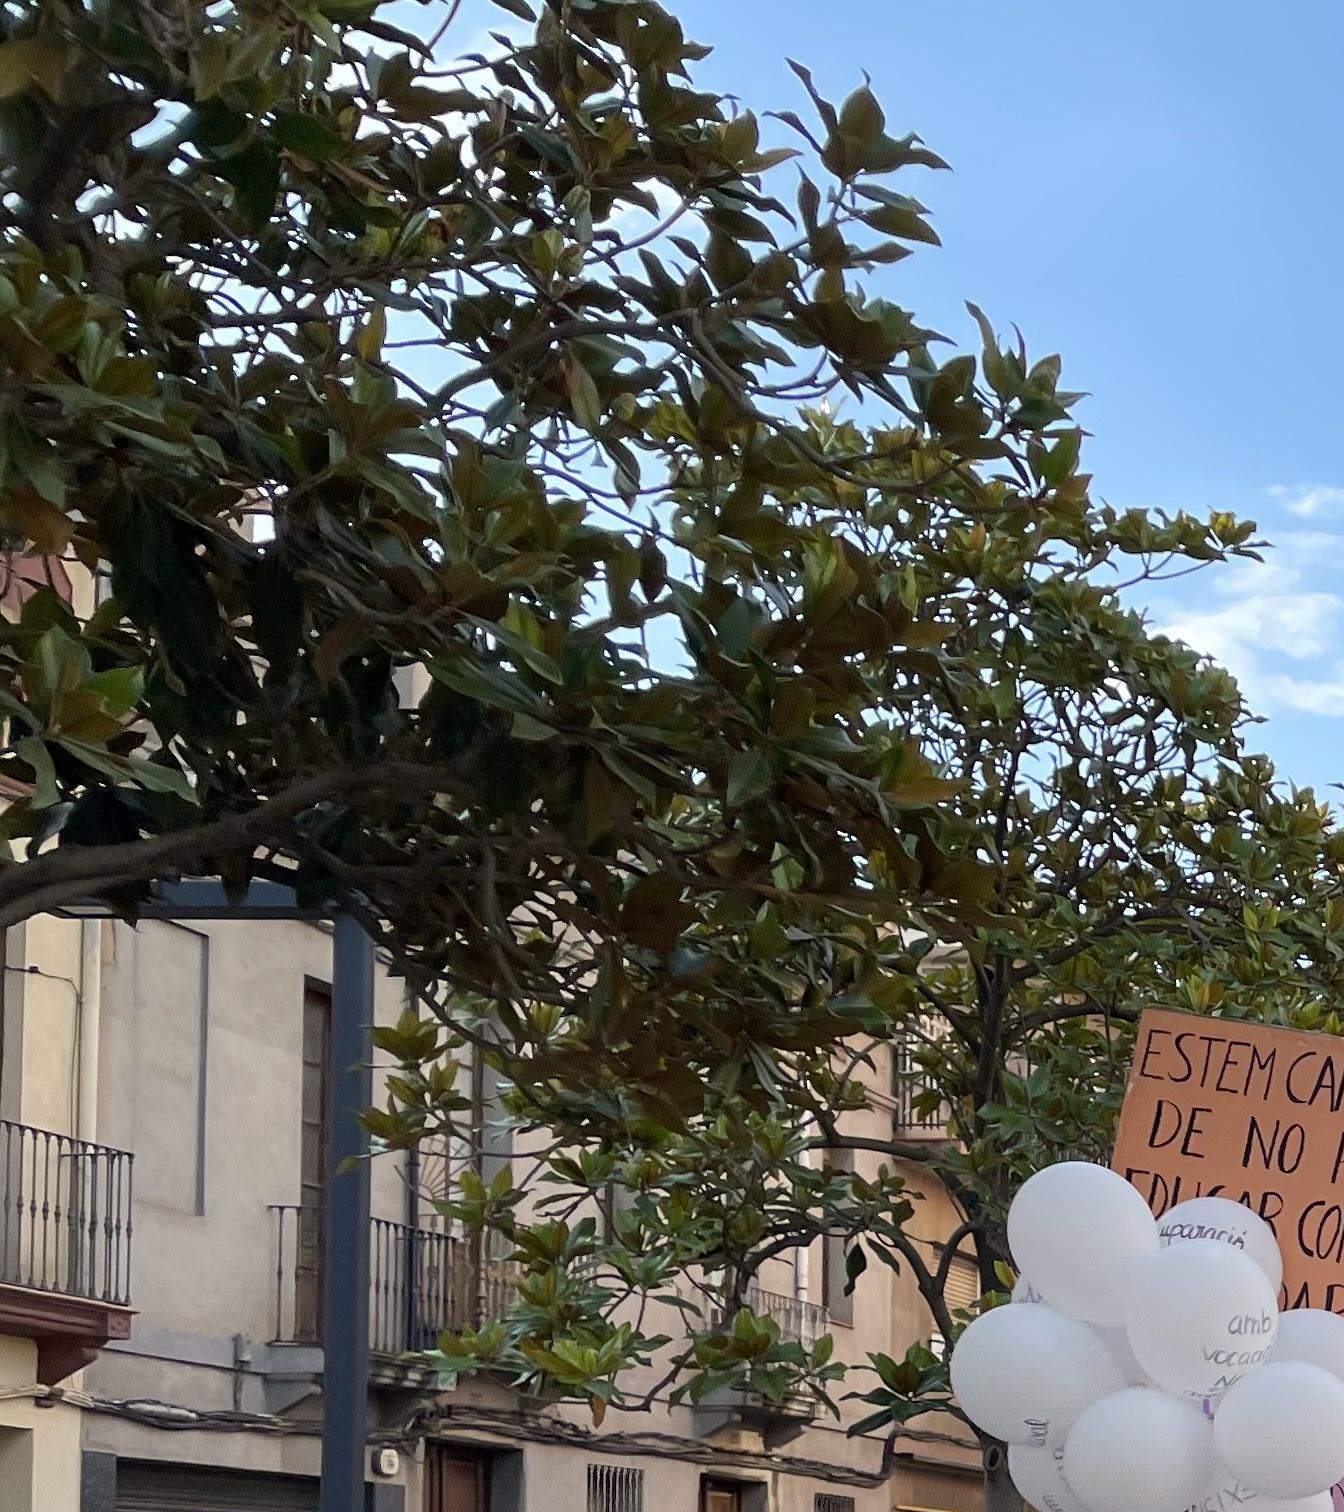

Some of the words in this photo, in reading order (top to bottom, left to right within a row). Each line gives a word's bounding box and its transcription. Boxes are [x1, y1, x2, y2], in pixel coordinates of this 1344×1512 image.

[1139, 1028, 1277, 1101] ESTEM
[1147, 1100, 1213, 1159] DE
[1242, 1116, 1307, 1174] NO
